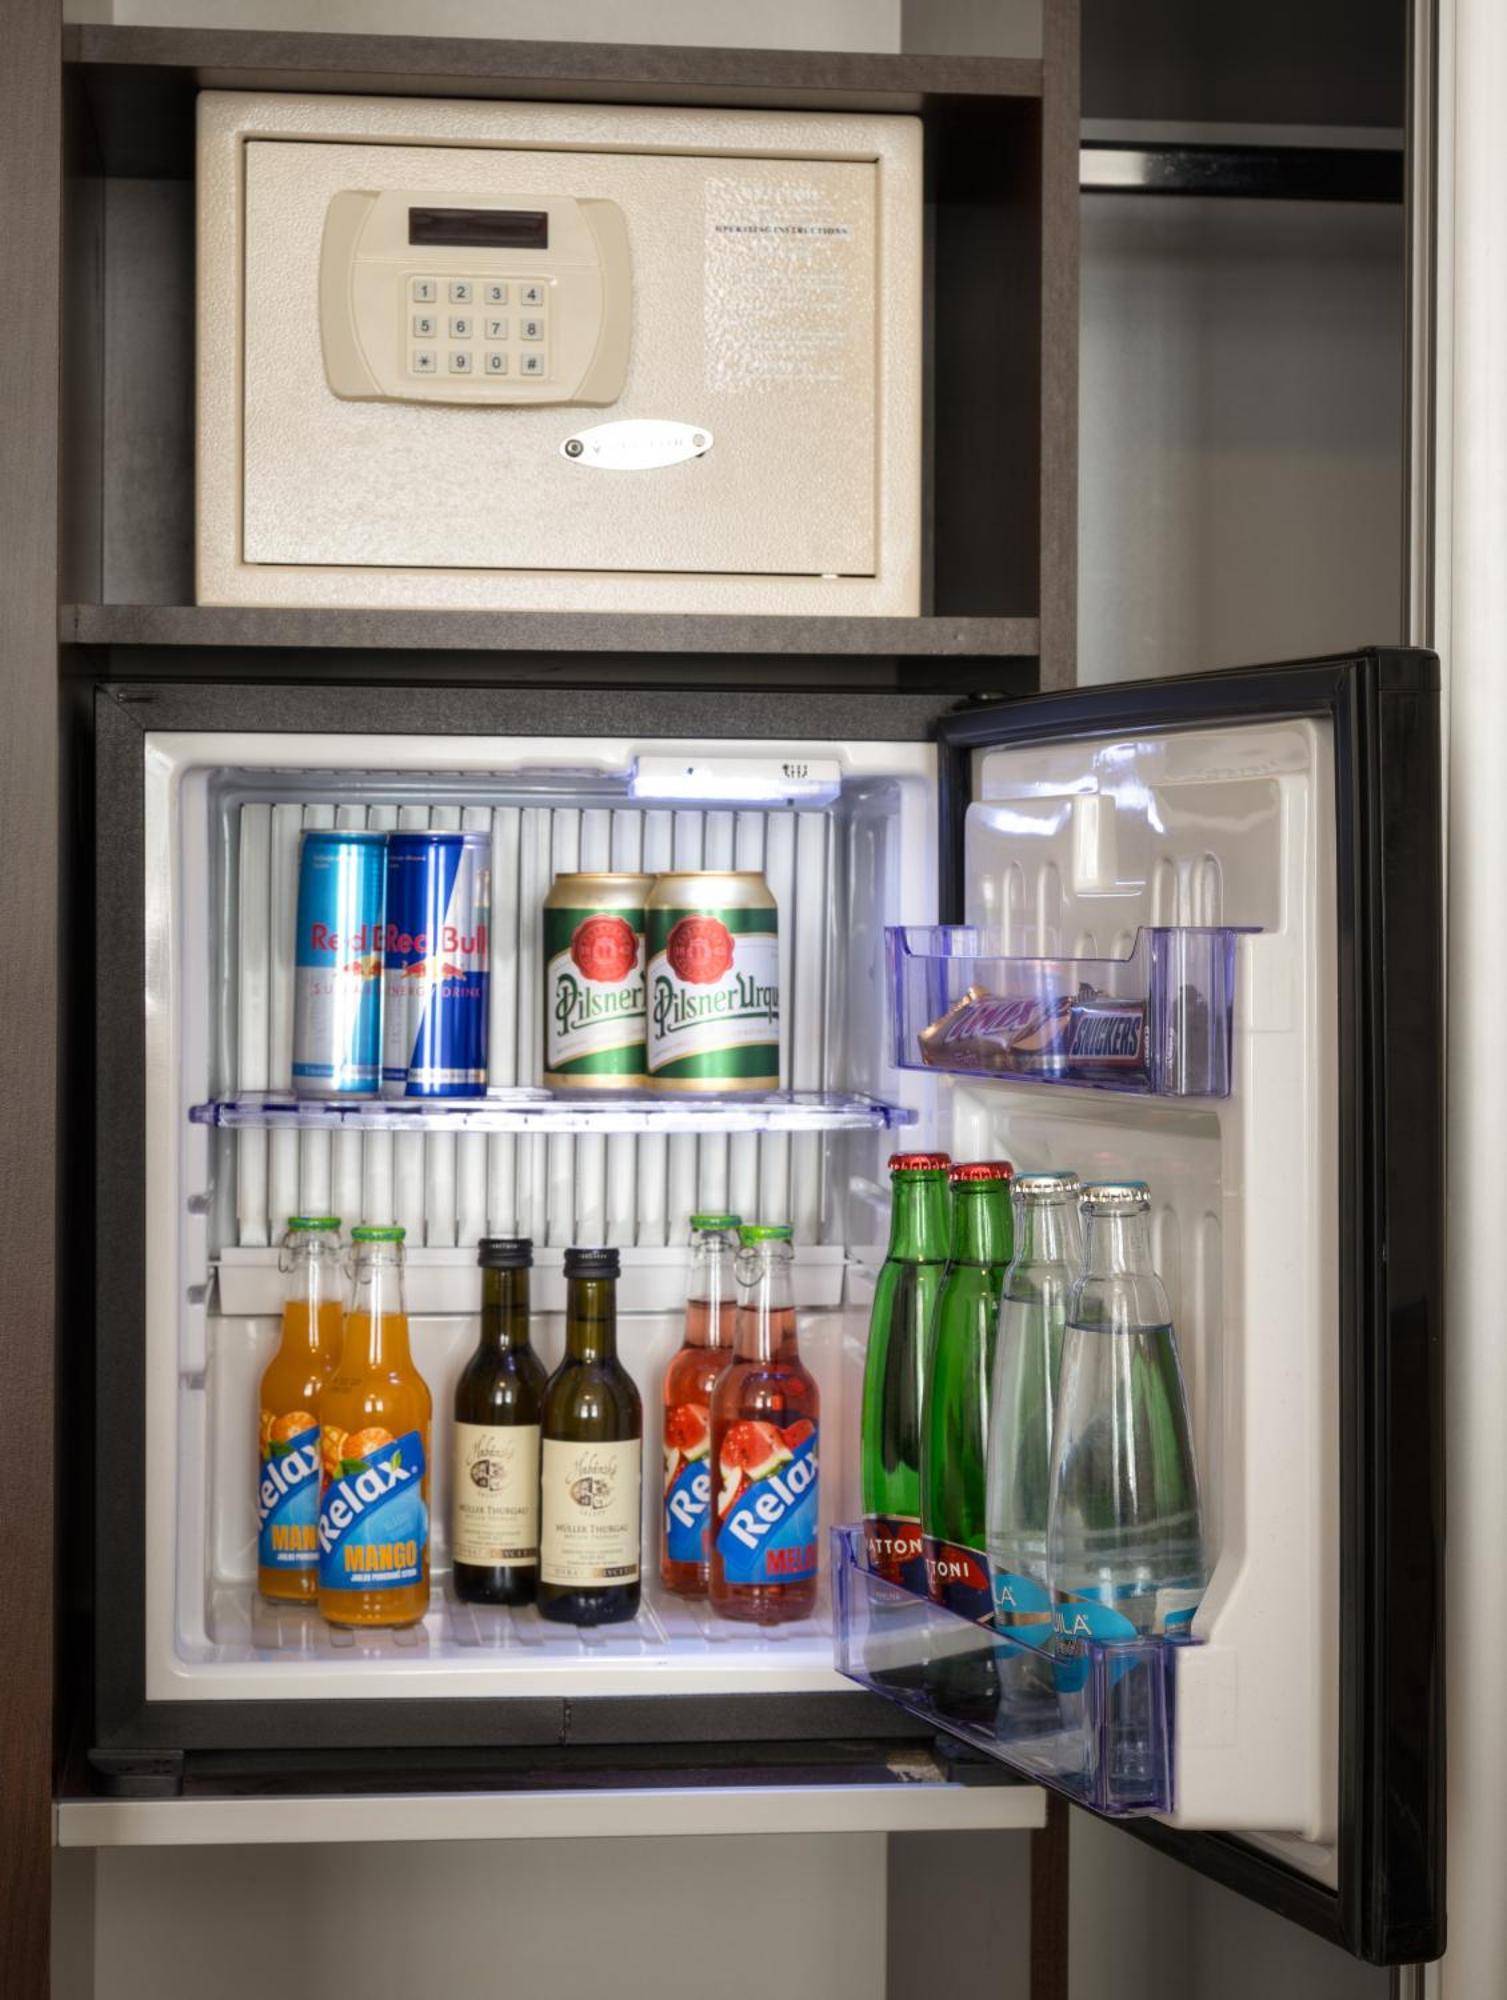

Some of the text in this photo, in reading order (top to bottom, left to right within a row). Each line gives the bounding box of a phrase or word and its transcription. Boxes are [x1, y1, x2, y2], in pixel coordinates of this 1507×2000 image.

[420, 285, 537, 300] 1 2 3 4
[420, 320, 537, 335] 5 6 7 8
[456, 356, 466, 368] 9
[491, 356, 502, 368] 0
[311, 922, 367, 951] Red
[442, 925, 488, 957] Bull
[555, 973, 642, 1037] Pilsner
[653, 974, 738, 1040] Pilsner
[1071, 1015, 1142, 1057] SNICKERS
[319, 1460, 411, 1554] Relax
[670, 1458, 711, 1528] Re
[344, 1539, 417, 1572] MANGO
